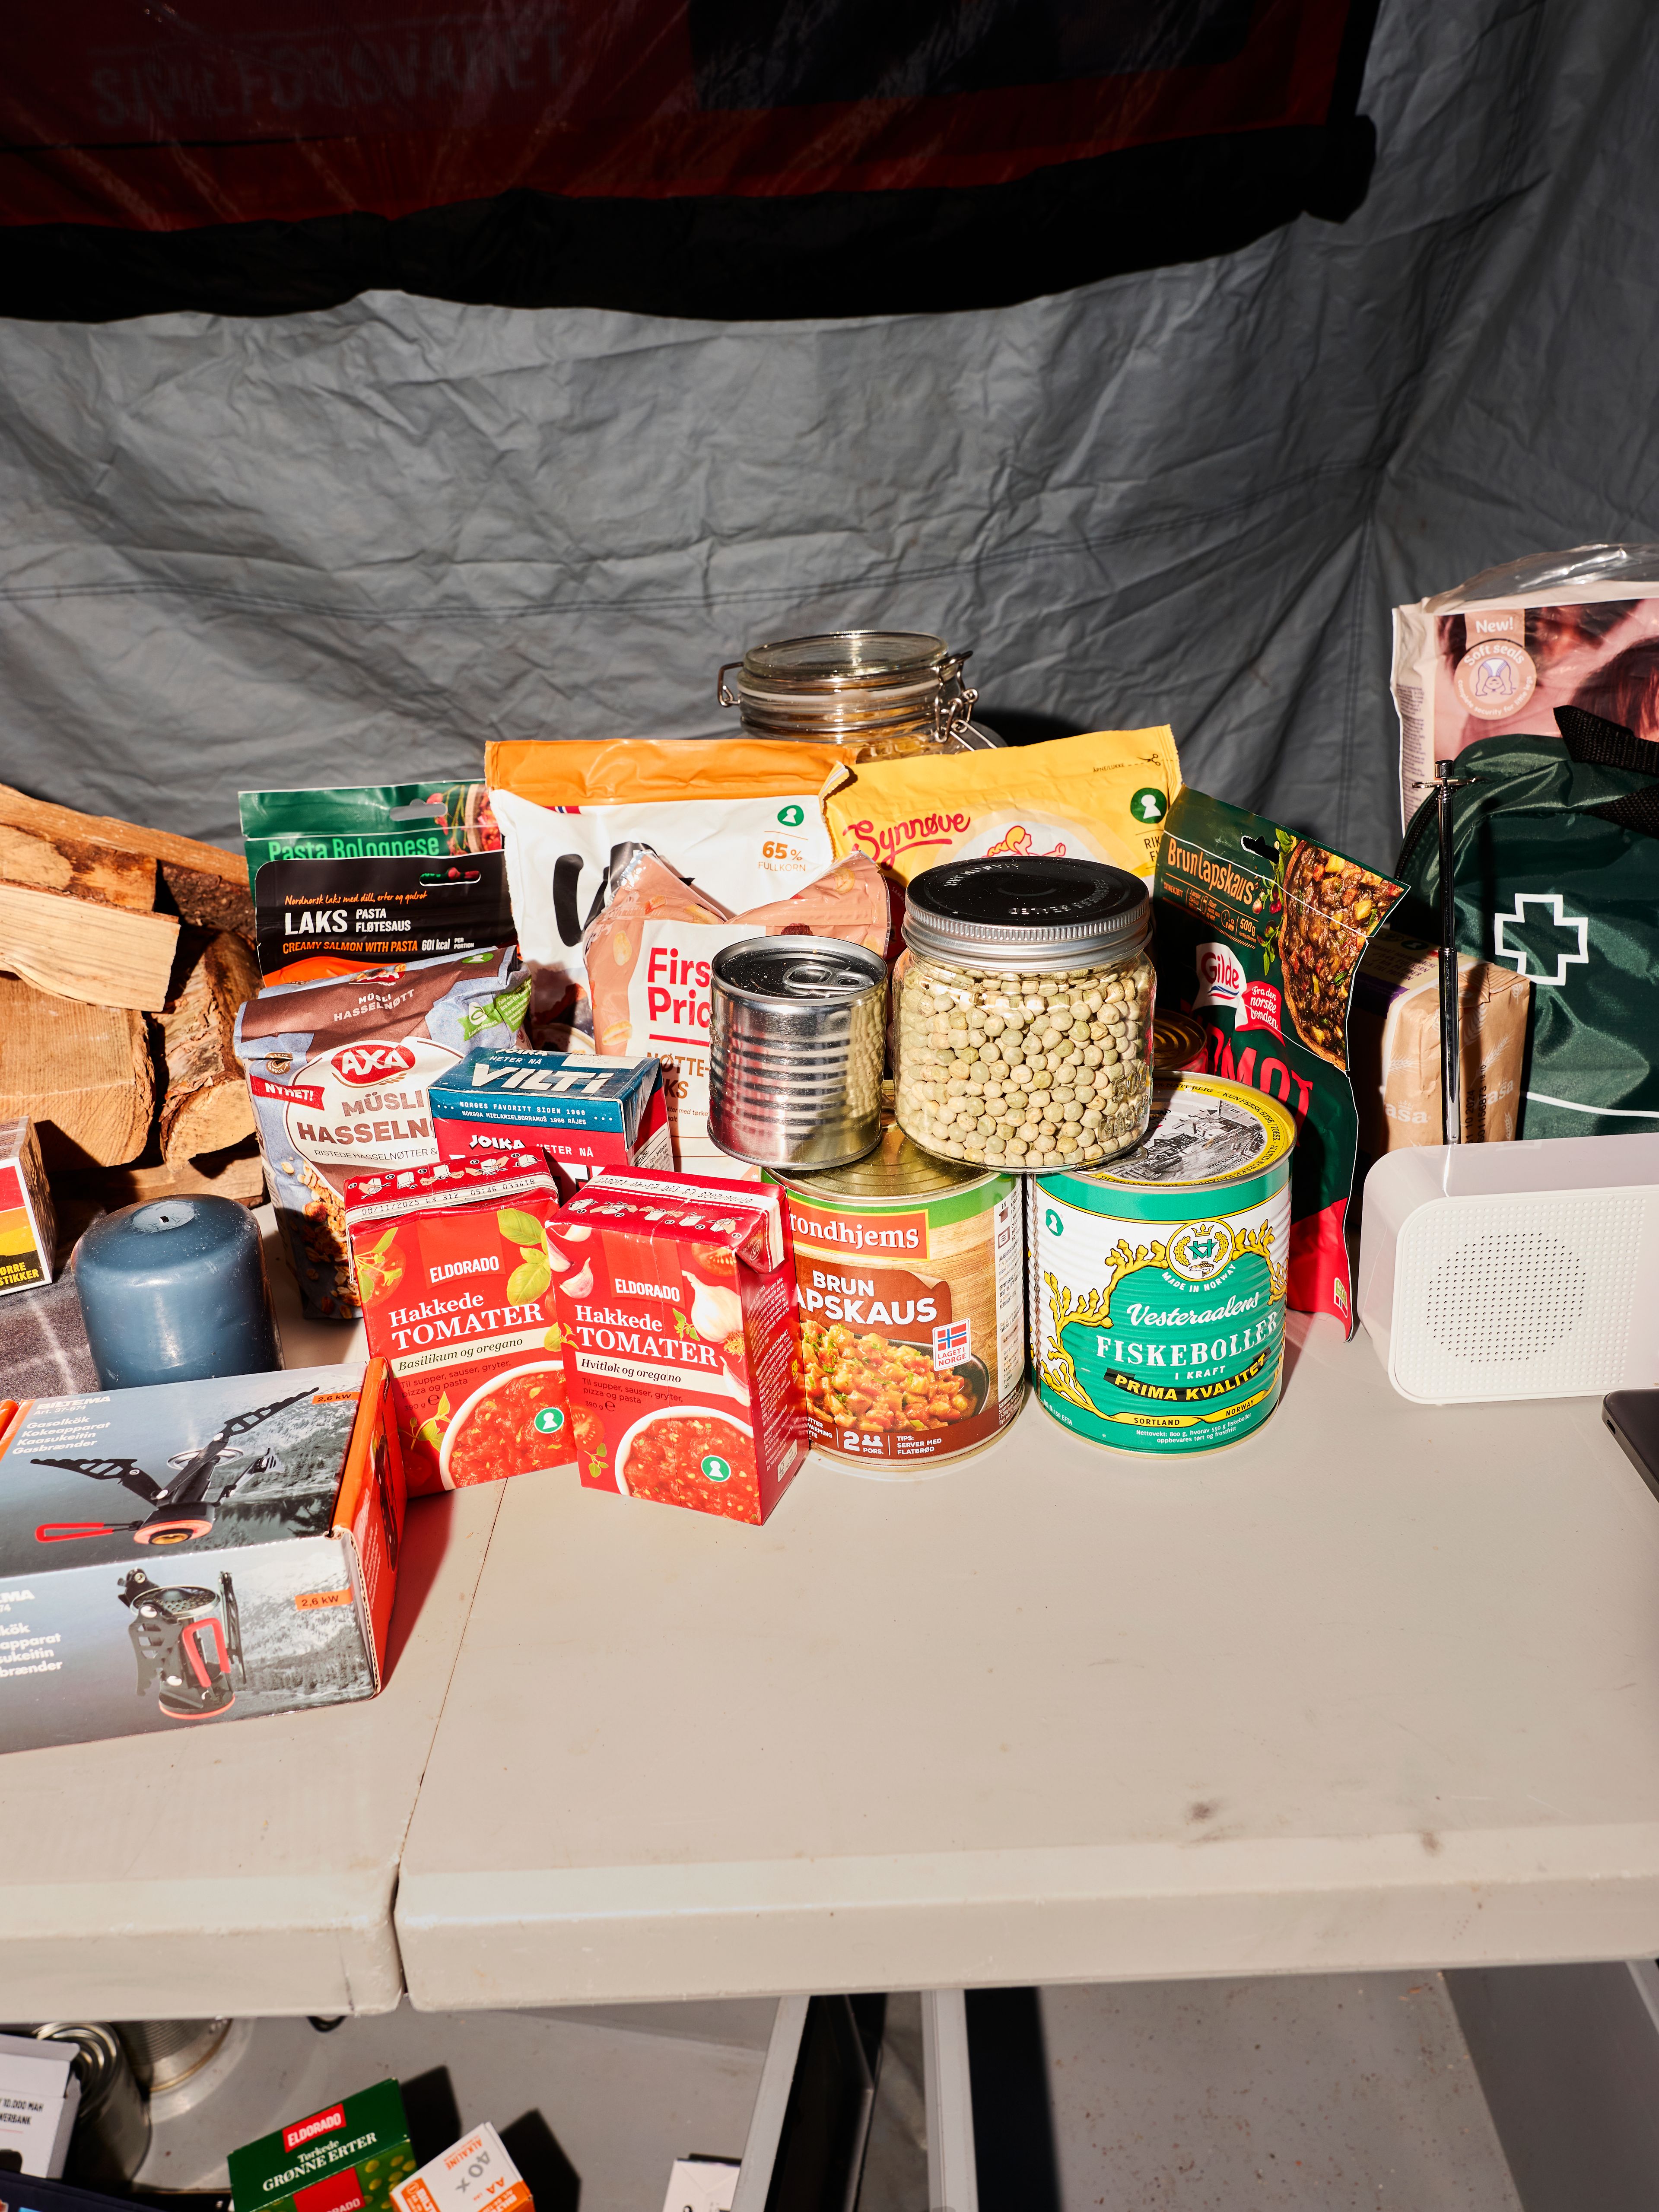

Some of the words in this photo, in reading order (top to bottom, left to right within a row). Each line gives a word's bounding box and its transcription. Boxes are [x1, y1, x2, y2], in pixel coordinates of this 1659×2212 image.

[1475, 617, 1514, 633] New!
[1464, 645, 1491, 666] Soft
[1493, 645, 1525, 664] seals
[1458, 680, 1474, 708] complete
[1514, 691, 1528, 706] little
[1523, 676, 1533, 691] legs
[268, 840, 327, 860] Pasta
[334, 836, 440, 859] Bolognese
[843, 813, 971, 871] Synnøve
[758, 861, 806, 871] FULLKORN
[285, 895, 324, 906] Nordnorsk
[343, 894, 359, 903] med
[360, 893, 375, 903] dill,
[395, 895, 403, 905] og
[285, 910, 348, 935] LAKS
[356, 909, 387, 919] PASTA
[356, 920, 411, 933] FLØTESAUS
[283, 941, 322, 954] CREAMY
[323, 942, 363, 952] SALMON
[365, 942, 388, 952] WITH
[390, 941, 418, 952] PASTA
[422, 940, 435, 950] 601
[436, 938, 450, 950] kcal
[648, 947, 711, 985] Firs
[1201, 951, 1239, 989] Gilde
[359, 993, 391, 1004] MÜSLI
[1252, 985, 1265, 996] Fra
[1265, 988, 1277, 1001] den
[334, 989, 415, 1021] HASSELNØTT
[648, 987, 710, 1027] Pric
[1250, 995, 1277, 1014] norske
[468, 1020, 497, 1037] Lantmännen
[1250, 1008, 1278, 1030] bonden
[341, 1050, 408, 1076] AXA
[265, 1083, 313, 1101] NYHET!
[1222, 1092, 1239, 1102] KUN
[1466, 1090, 1475, 1114] 2024
[1483, 1080, 1513, 1105] asa
[341, 1090, 424, 1117] MÜSLI
[493, 1103, 531, 1112] FAVORITT
[1239, 1098, 1262, 1114] FERSK
[1385, 1103, 1428, 1123] asa
[1270, 1125, 1281, 1141] TORSK
[315, 1149, 352, 1159] RISTEDE
[353, 1149, 429, 1161] HASSELNØTTER
[469, 1135, 526, 1150] JOIKA
[579, 1146, 594, 1157] NÅ
[1264, 1144, 1279, 1162] ALLTID
[1238, 1159, 1265, 1177] NORSKE
[362, 1199, 420, 1215] 08/11/2025
[470, 1185, 497, 1195] 05:46
[790, 1214, 920, 1250] rondhjems
[0, 1262, 26, 1276] ØRRE
[0, 1269, 40, 1286] STIKKER
[430, 1256, 499, 1284] ELDORADO
[1161, 1271, 1186, 1290] MADE
[1203, 1263, 1237, 1292] NORWAY
[616, 1279, 680, 1303] ELDORADO
[813, 1270, 874, 1297] BRUN
[388, 1292, 484, 1328] Hakkede
[796, 1283, 937, 1325] APSKAUS
[1126, 1290, 1260, 1327] Vesteraalens
[391, 1303, 544, 1351] TOMATER
[575, 1305, 662, 1332] Hakkede
[576, 1326, 718, 1367] TOMATER
[1096, 1311, 1278, 1367] FISKEBOLLER
[398, 1352, 458, 1371] Basilikum
[461, 1348, 474, 1358] og
[477, 1338, 523, 1354] oregano
[938, 1349, 962, 1360] LAGET
[938, 1354, 966, 1367] NORGE
[400, 1380, 410, 1389] Til
[413, 1373, 447, 1388] supper,
[449, 1366, 480, 1378] sauser,
[482, 1360, 511, 1373] gryter,
[581, 1358, 620, 1373] Hvitløk
[622, 1367, 635, 1378] og
[637, 1370, 681, 1384] oregano
[1115, 1374, 1177, 1401] PRIMA
[1185, 1354, 1267, 1401] KVALITET
[1187, 1365, 1227, 1379] KRAFT
[401, 1389, 426, 1398] pizza
[429, 1385, 440, 1393] og
[444, 1378, 468, 1390] pasta
[582, 1378, 592, 1386] Til
[594, 1379, 623, 1392] supper,
[625, 1385, 653, 1398] sauser,
[655, 1391, 683, 1403] gryter,
[584, 1387, 604, 1398] pizza
[607, 1392, 617, 1401] og
[619, 1394, 641, 1404] pasta
[36, 1396, 111, 1410] BILTEMA
[55, 1405, 86, 1414] 37-674
[1134, 1417, 1180, 1425] SORTLAND
[1226, 1399, 1255, 1417] NORWAY
[22, 1422, 111, 1438] Kokeapparat
[27, 1416, 90, 1429] Gasolkök
[1062, 1415, 1073, 1426] EFTA
[1227, 1413, 1252, 1428] fiskeboller
[17, 1432, 96, 1446] Kaasukeitin
[843, 1431, 860, 1452] 2
[1214, 1426, 1236, 1438] frostfritt
[12, 1440, 98, 1455] Gasbrænder
[897, 1440, 925, 1448] SERVER
[897, 1446, 934, 1455] FLATBRØD
[302, 1598, 319, 1607] 2,6
[322, 1595, 339, 1605] kW
[0, 1633, 61, 1651] apparat
[0, 1660, 63, 1678] brænder
[287, 2113, 341, 2147] ELDORADO
[297, 2140, 339, 2162] Tørkede
[445, 2138, 483, 2171] ALKALINE
[263, 2155, 327, 2191] GRØNNE
[328, 2132, 377, 2163] ERTER
[468, 2151, 490, 2178] 40
[486, 2177, 505, 2194] AA
